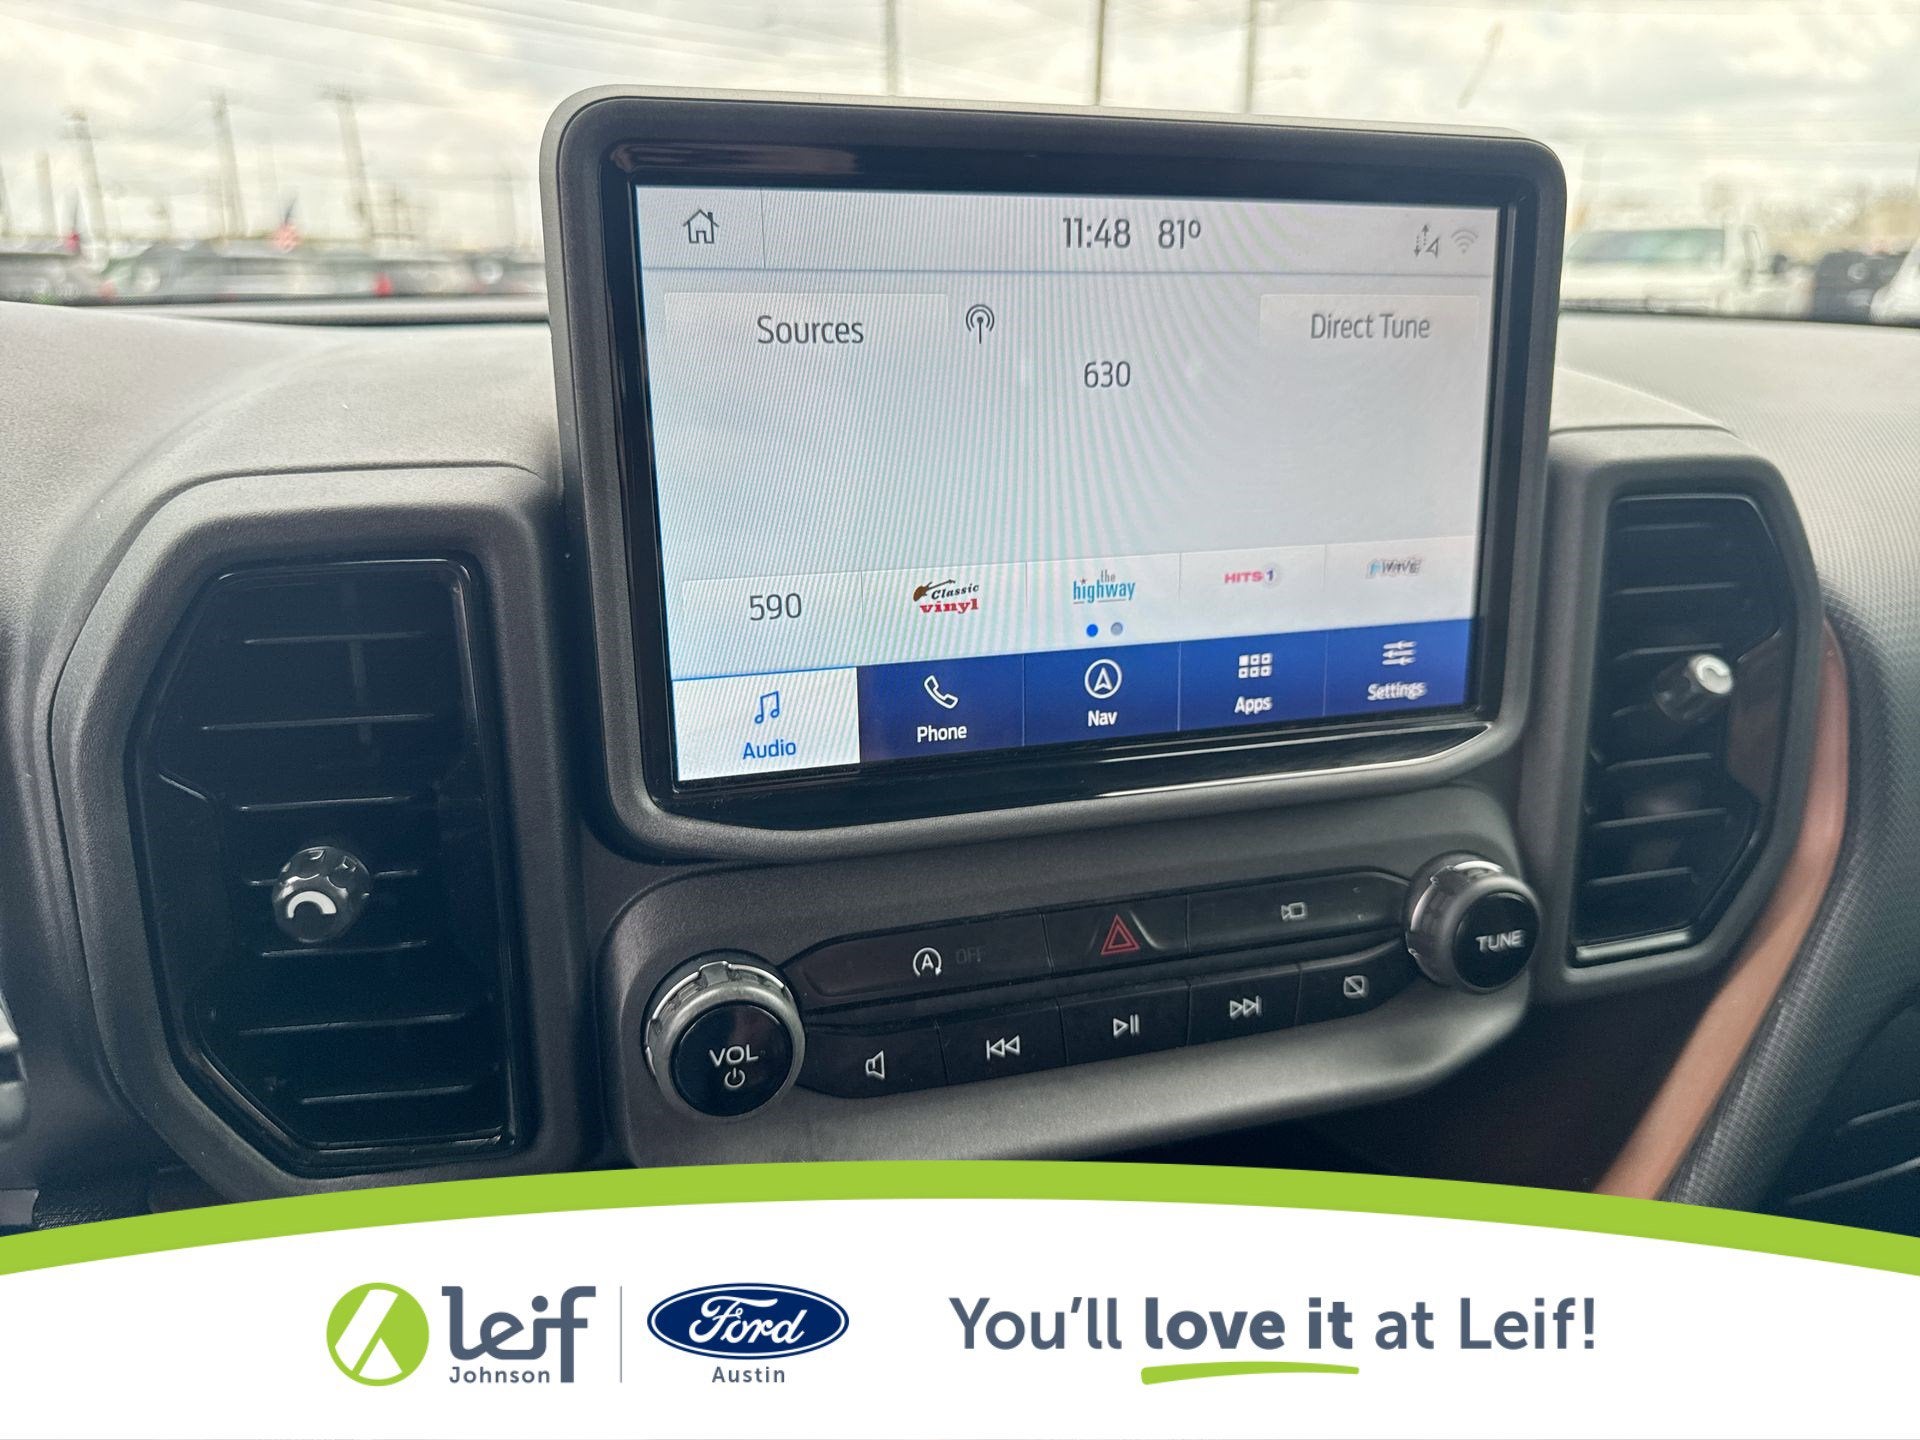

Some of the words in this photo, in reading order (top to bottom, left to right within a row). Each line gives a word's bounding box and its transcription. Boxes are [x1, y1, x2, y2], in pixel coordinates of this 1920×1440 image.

[1062, 217, 1131, 249] 11:48
[757, 315, 864, 344] Sources
[1311, 313, 1373, 339] Direct
[1380, 313, 1431, 339] Tune
[1084, 361, 1131, 388] 630
[1100, 570, 1116, 583] the
[1224, 571, 1262, 584] HITS
[931, 582, 980, 600] Classic
[1073, 579, 1136, 603] highway
[750, 592, 801, 621] 590
[920, 598, 979, 614] vinyl
[1367, 681, 1427, 701] Settings
[1234, 696, 1273, 715] Apps
[1087, 709, 1118, 727] Nav
[917, 724, 967, 742] Phone
[743, 739, 796, 760] Audio
[1476, 929, 1523, 953] TUNE
[709, 1045, 759, 1067] VOL
